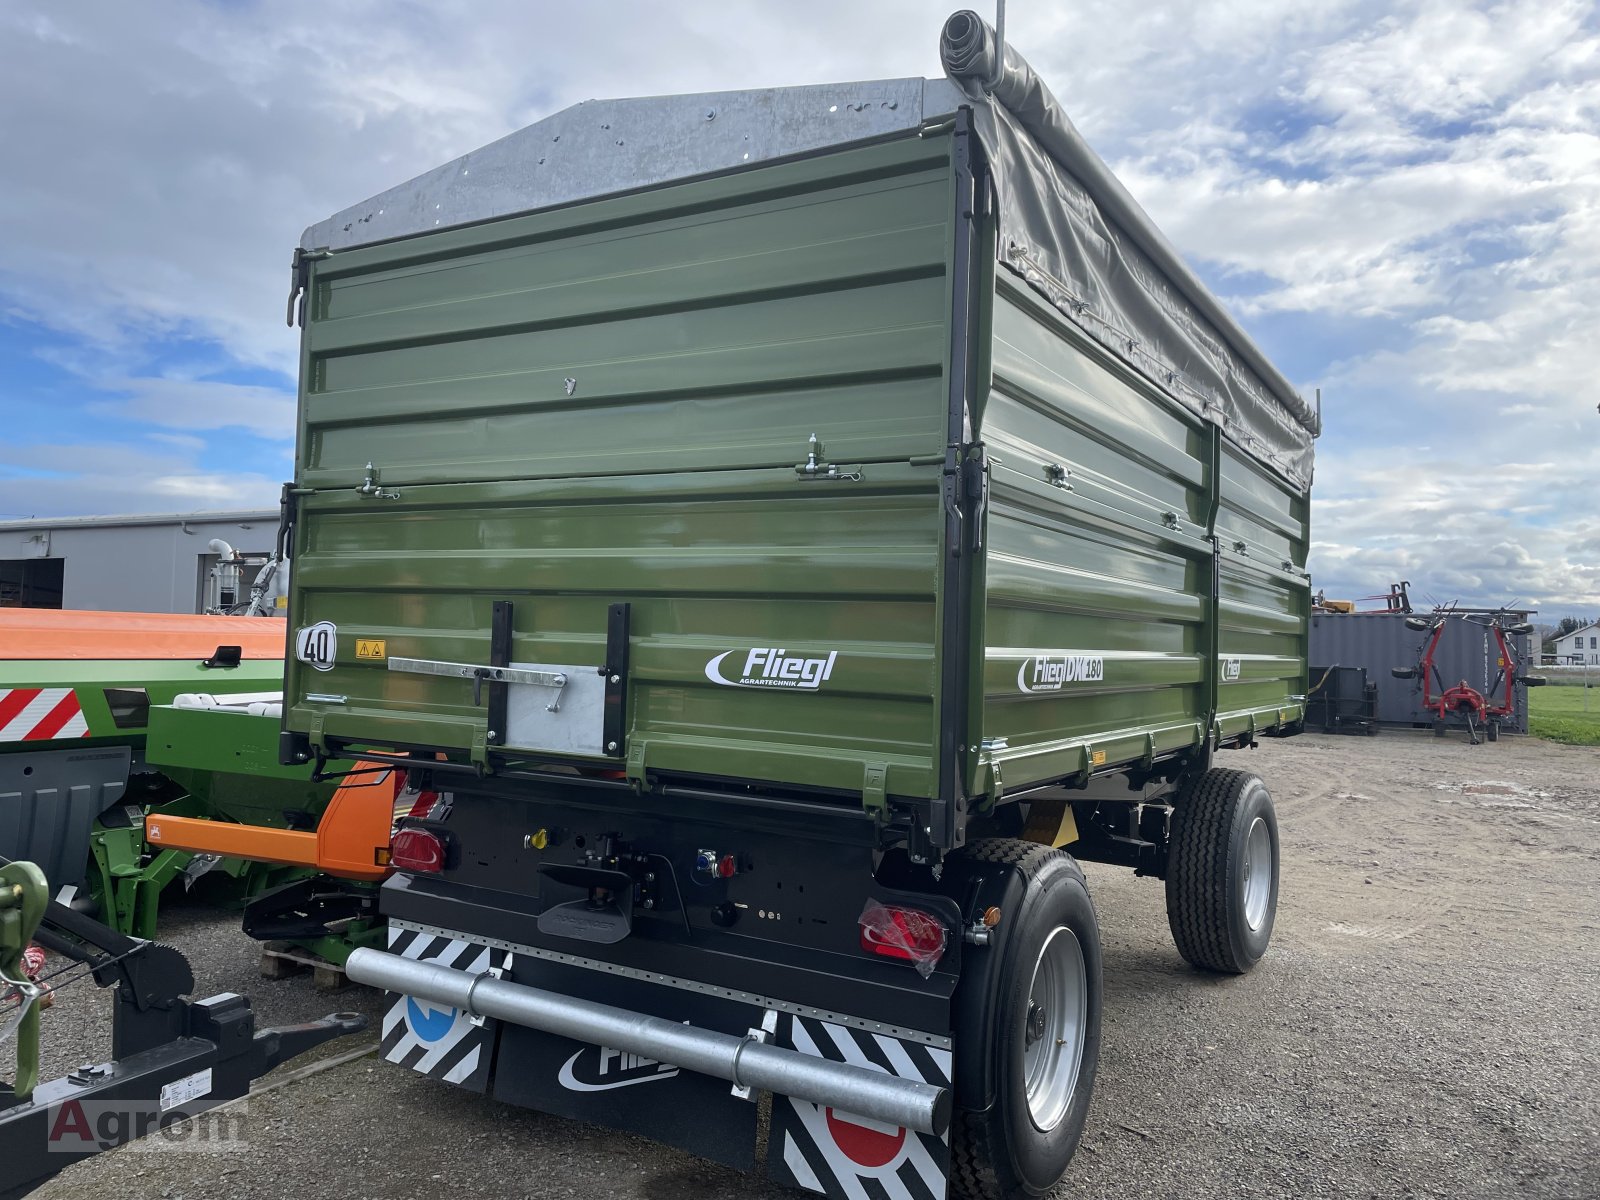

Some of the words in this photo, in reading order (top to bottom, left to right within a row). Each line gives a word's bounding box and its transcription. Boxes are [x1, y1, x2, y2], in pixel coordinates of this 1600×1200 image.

[304, 629, 328, 663] 40
[739, 678, 797, 687] AGRARTECHNIK
[742, 648, 838, 688] Fliegl
[1033, 656, 1067, 689] Fliegl
[1066, 656, 1084, 682] DK
[1085, 659, 1102, 679] 180
